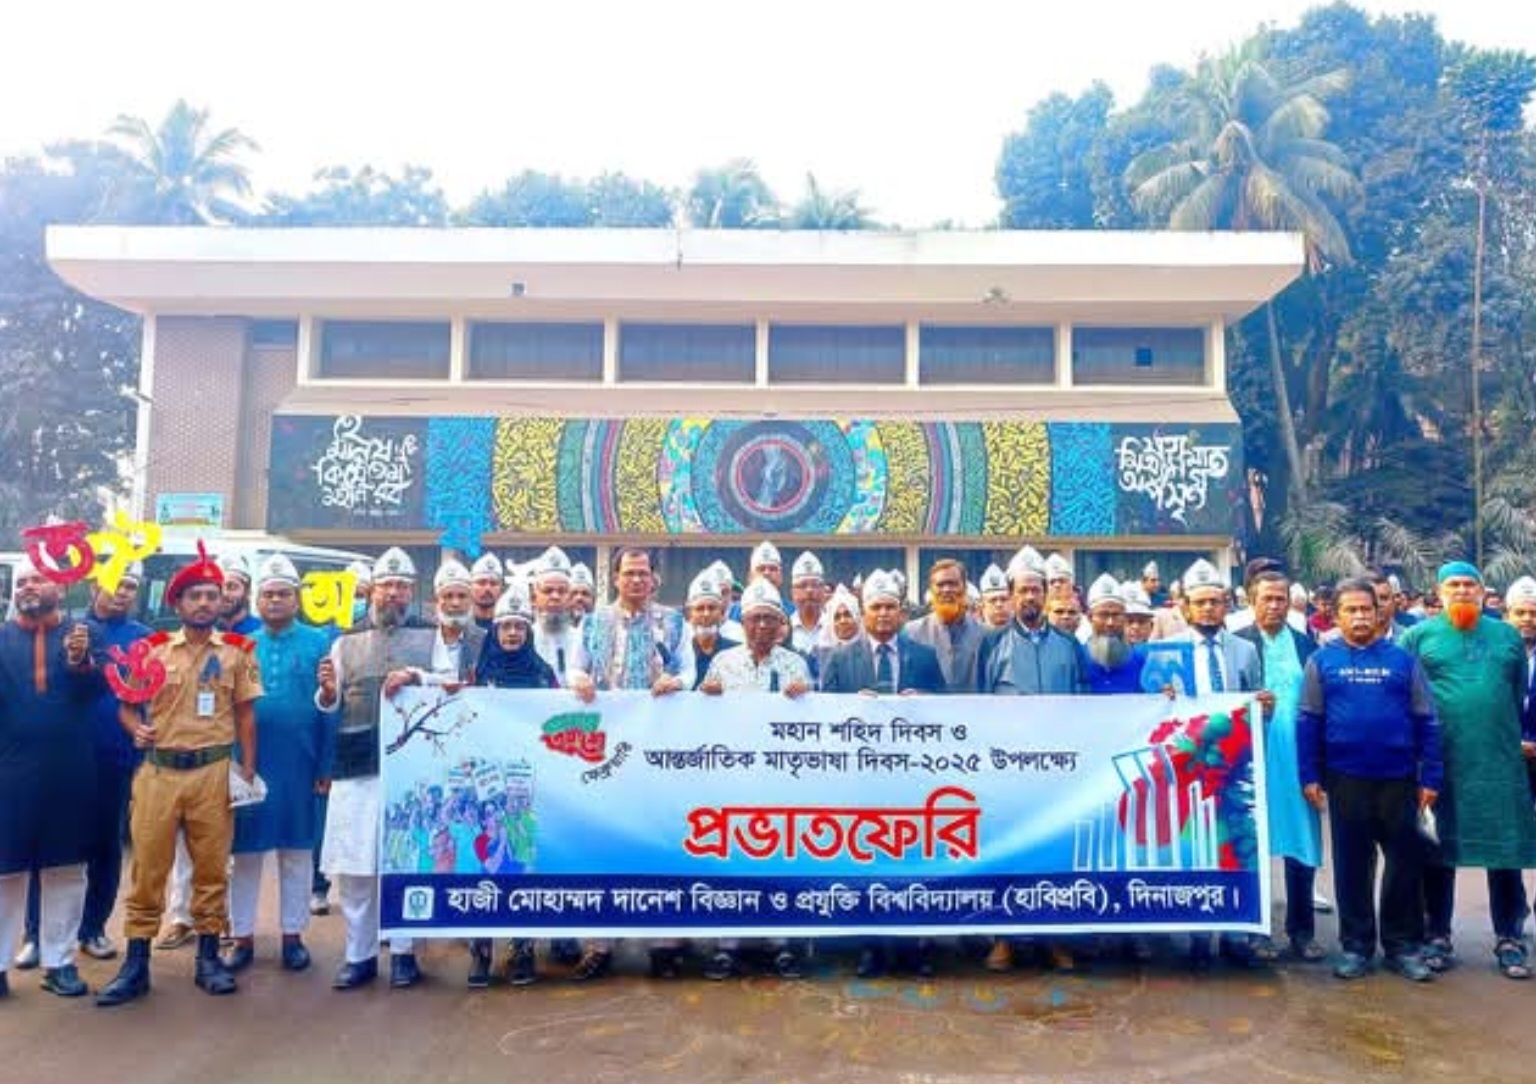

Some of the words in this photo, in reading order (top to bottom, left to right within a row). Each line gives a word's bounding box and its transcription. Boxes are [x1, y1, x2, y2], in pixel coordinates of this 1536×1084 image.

[770, 721, 820, 742] মহান
[829, 718, 882, 742] শহিদ
[891, 718, 943, 742] দিবস
[951, 723, 968, 742] ও
[643, 745, 757, 771] আন্তর্জাতিক
[763, 749, 849, 778] মাতৃভাষা
[857, 747, 981, 775] দিবস-২০২৫
[990, 748, 1078, 773] উপলক্ষ্যে
[683, 785, 982, 862] প্রভাতফেরি
[446, 880, 501, 914] হাজী
[508, 886, 604, 913] মোহাম্মদ
[611, 886, 683, 914] দানেশ
[690, 883, 761, 913] বিজ্ঞান
[769, 889, 788, 912] ও
[796, 883, 861, 917] প্রযুক্তি
[867, 882, 995, 915] বিশ্ববিদ্যালয়
